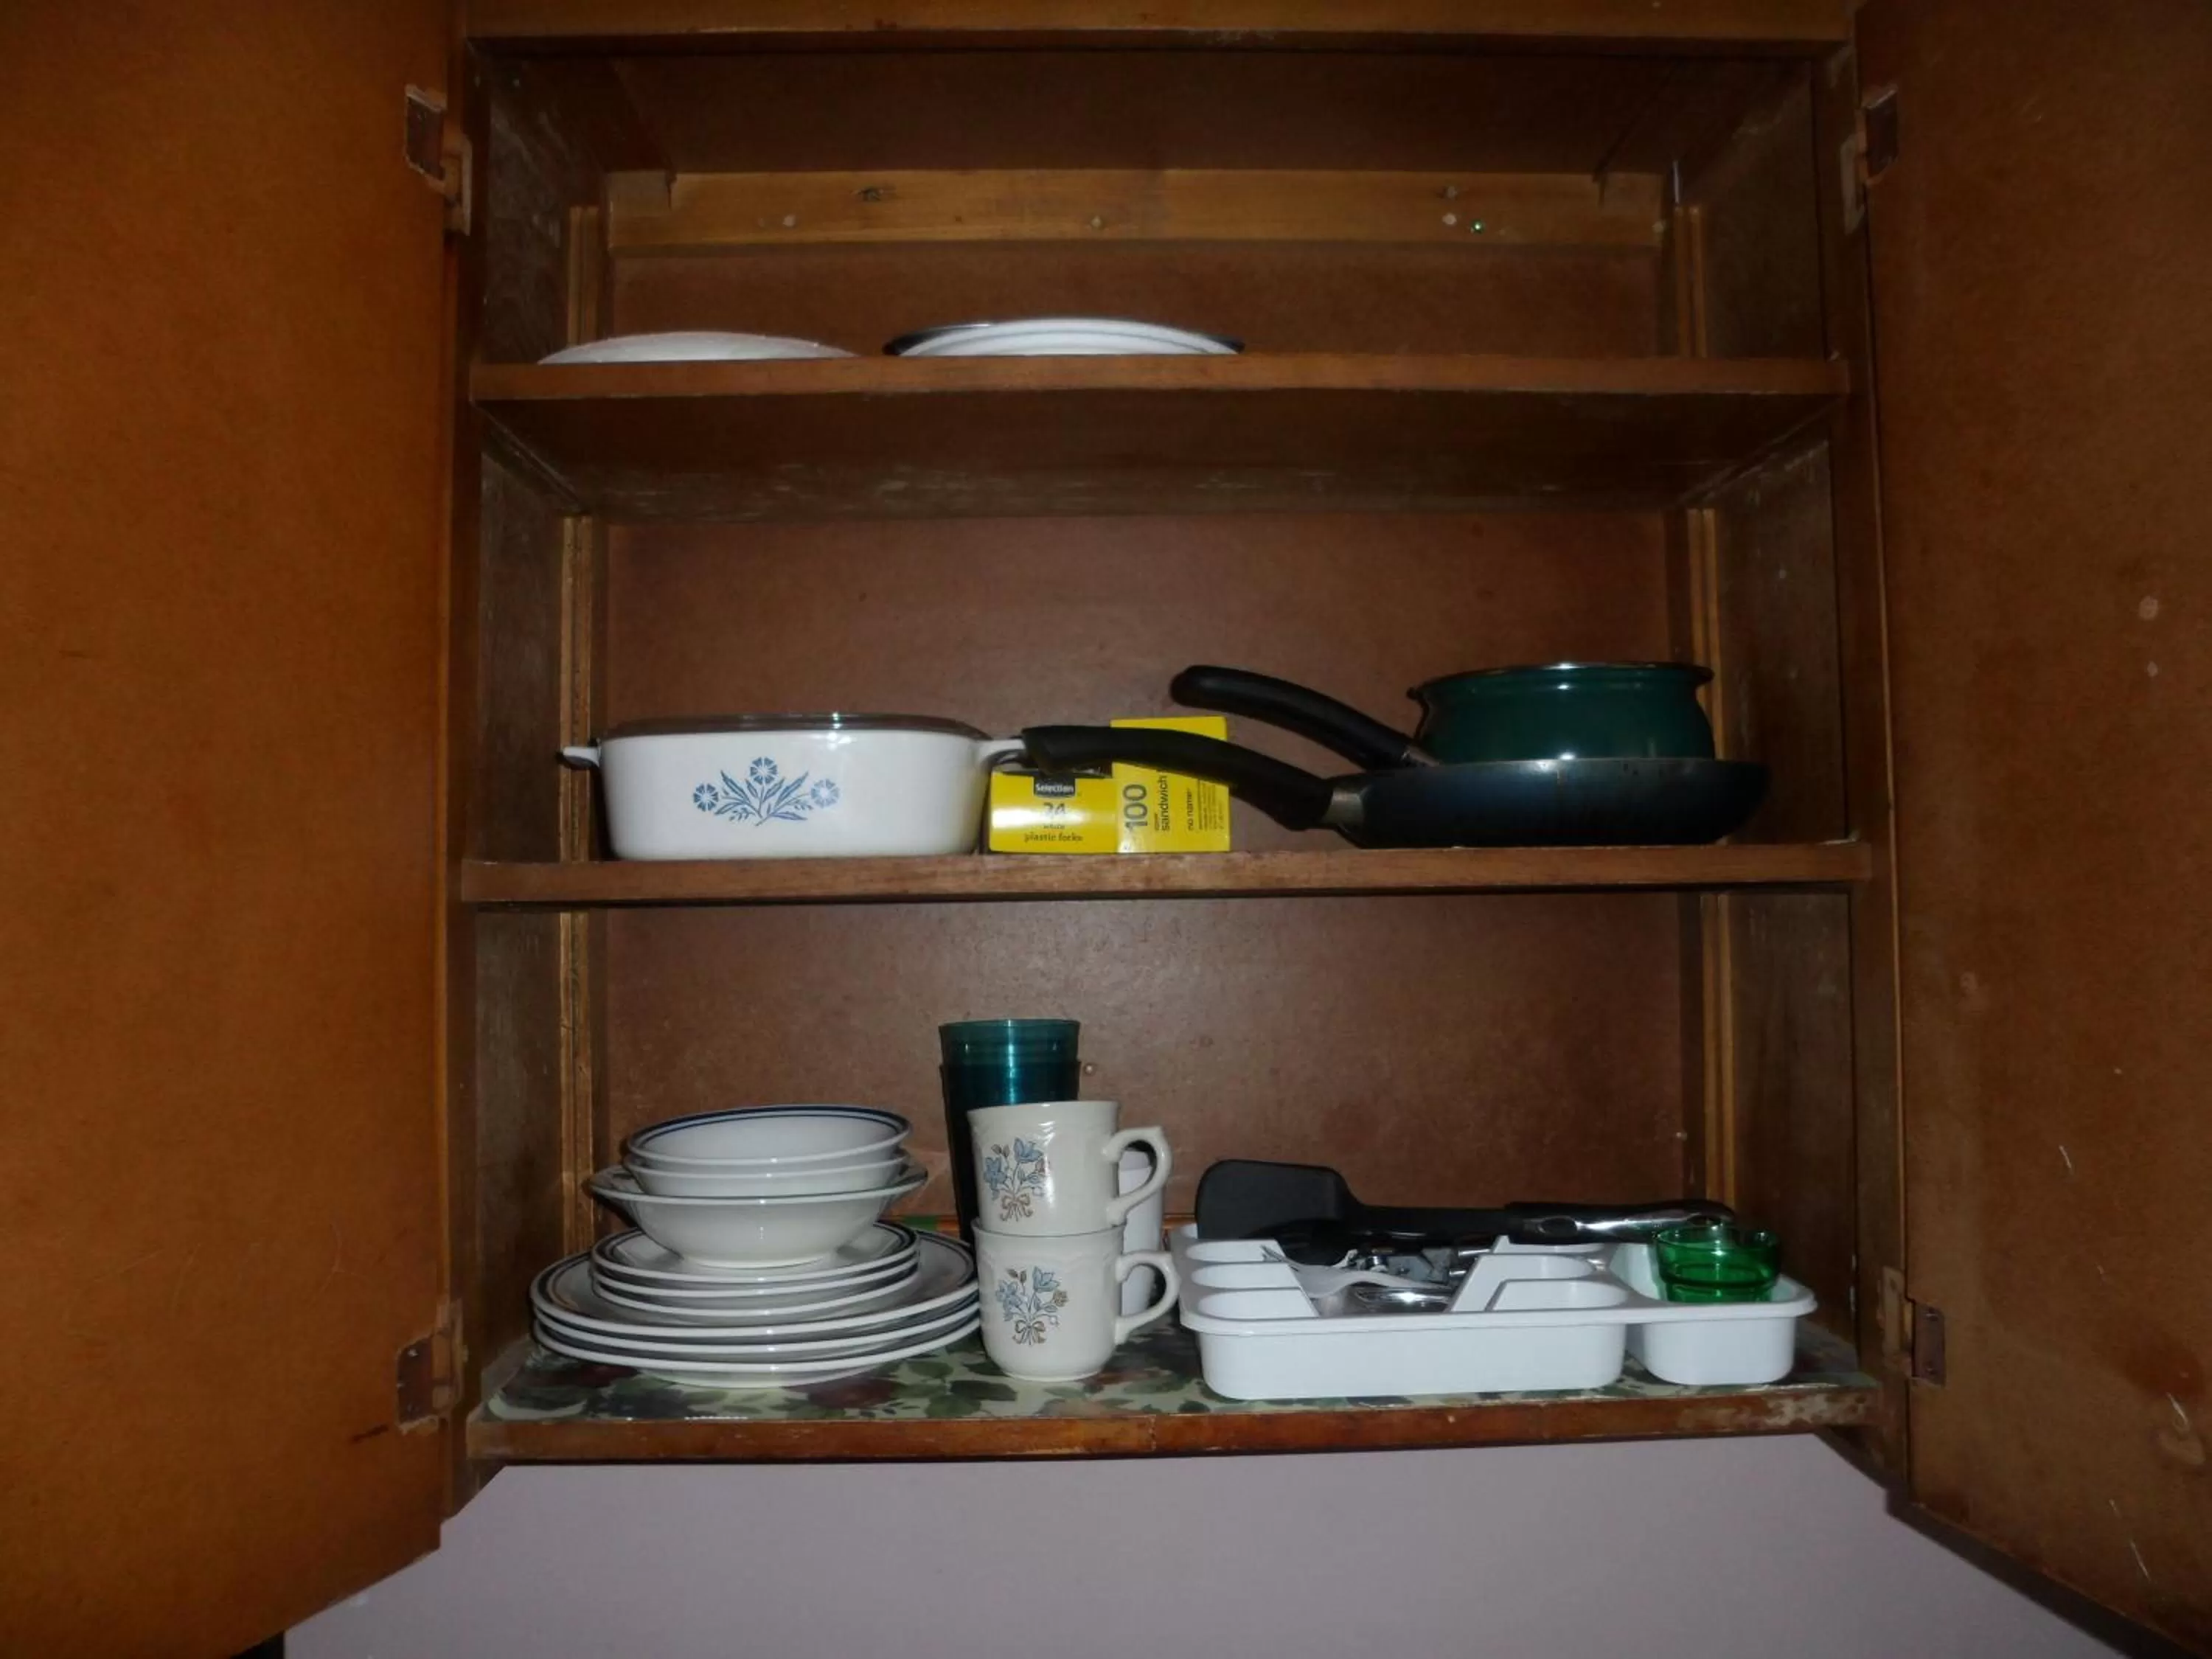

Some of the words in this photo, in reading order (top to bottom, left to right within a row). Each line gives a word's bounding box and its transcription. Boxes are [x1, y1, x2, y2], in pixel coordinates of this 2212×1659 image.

[1035, 784, 1074, 793] Selection
[1123, 784, 1148, 832] 100
[1158, 775, 1169, 832] sandwich
[1024, 831, 1056, 842] plastic
[1058, 831, 1084, 841] forks
